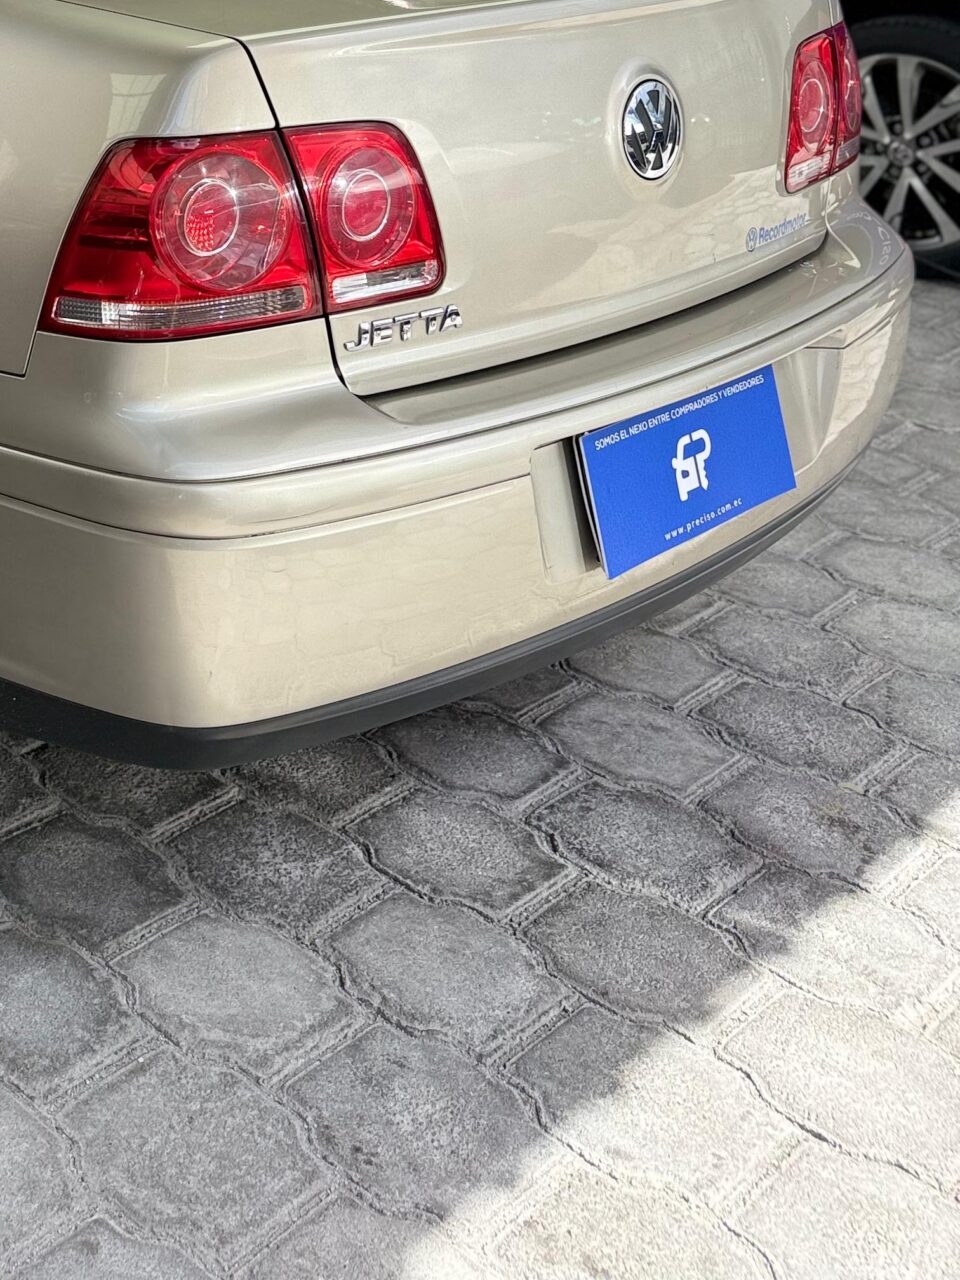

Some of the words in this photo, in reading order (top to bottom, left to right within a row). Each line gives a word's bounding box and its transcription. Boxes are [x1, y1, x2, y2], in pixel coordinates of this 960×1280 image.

[343, 303, 463, 352] JETTA
[594, 432, 621, 451] SOMOS
[620, 429, 630, 440] EL
[628, 421, 648, 436] NEXO
[647, 411, 671, 429] ENTRE
[670, 392, 719, 419] COMPRADORES
[717, 390, 724, 400] Y
[722, 374, 765, 398] VENDEDORES
[664, 497, 743, 541] www.preciso.com.ec
